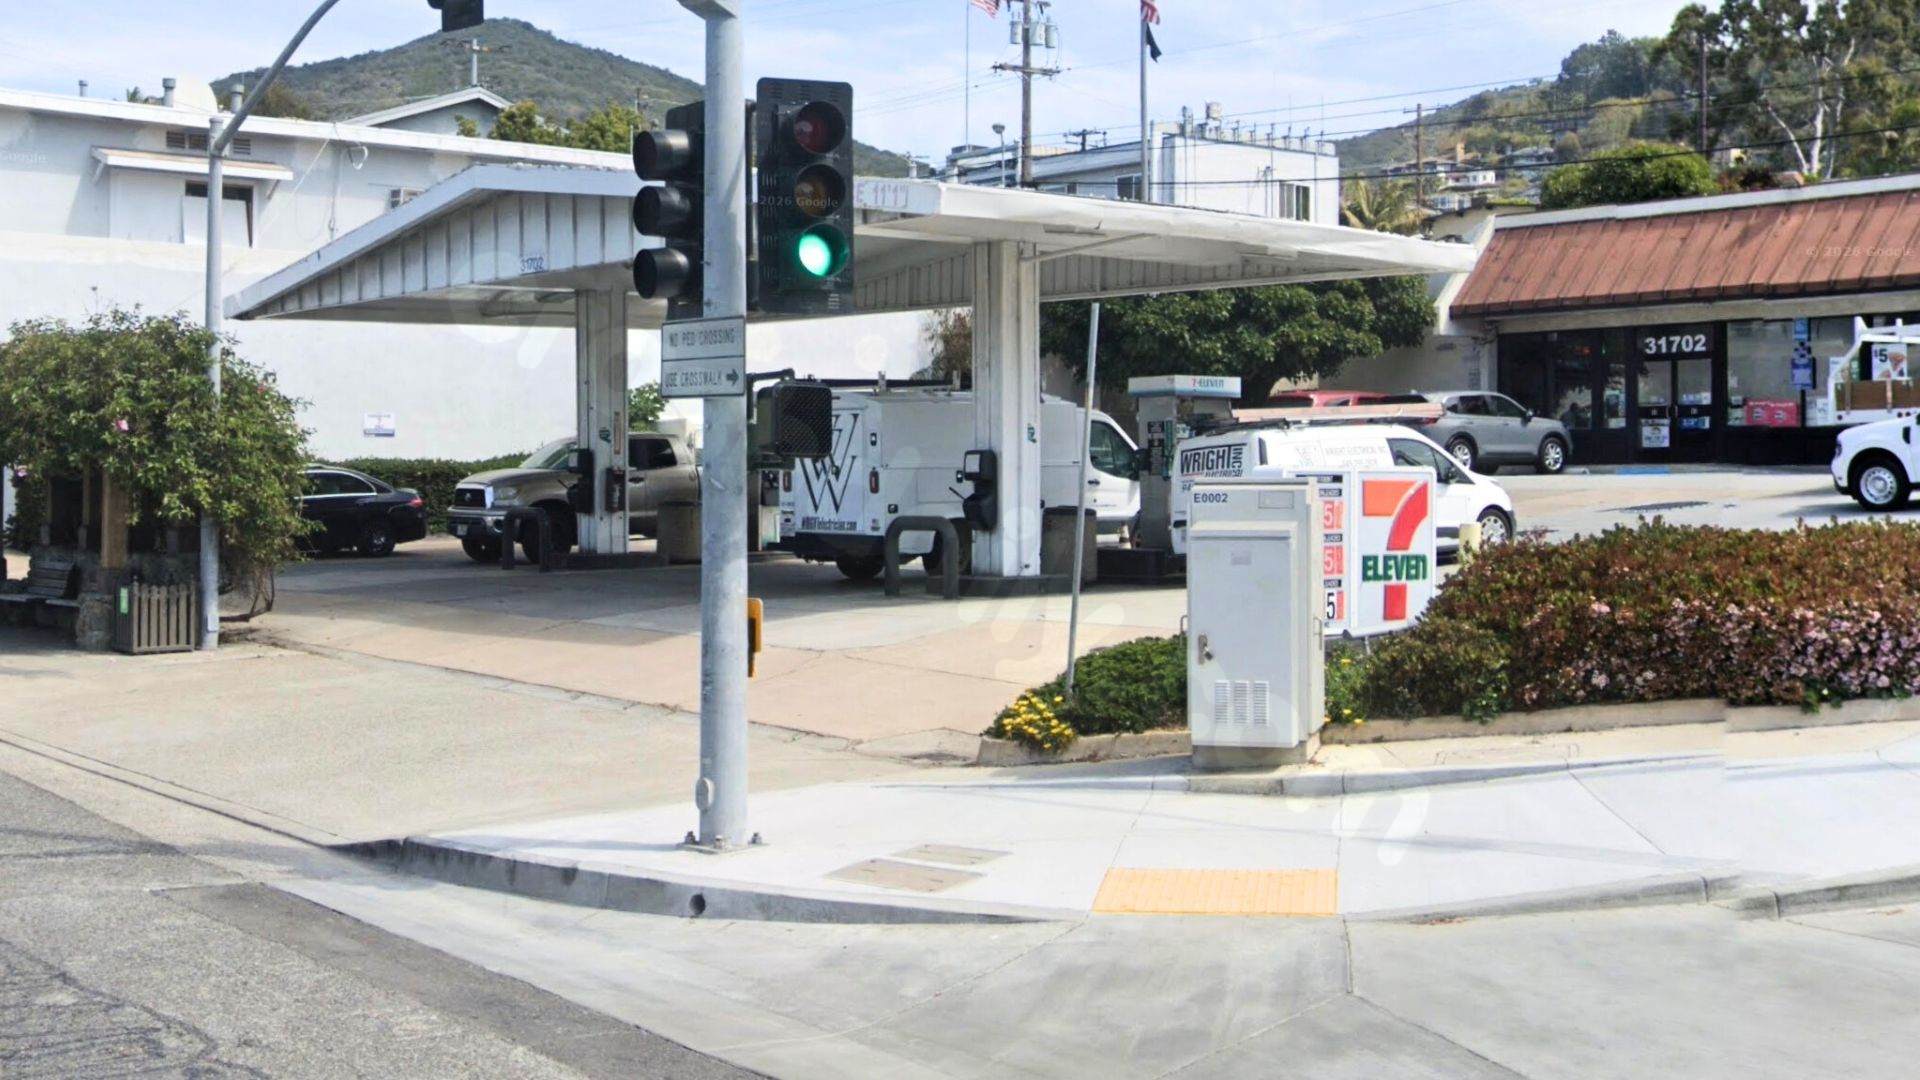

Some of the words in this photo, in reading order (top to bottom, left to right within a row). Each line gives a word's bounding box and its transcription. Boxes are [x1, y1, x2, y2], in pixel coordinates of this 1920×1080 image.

[669, 331, 679, 348] NO
[682, 330, 697, 346] PED
[699, 326, 736, 346] CROSSING
[1644, 334, 1706, 355] 31702
[680, 369, 723, 386] CROSSWALK
[1181, 445, 1232, 474] WRIGHT
[1231, 447, 1243, 469] INC
[1193, 492, 1228, 503] E0002
[1324, 502, 1334, 529] 5
[1324, 550, 1335, 574] 5
[1326, 592, 1336, 620] 5
